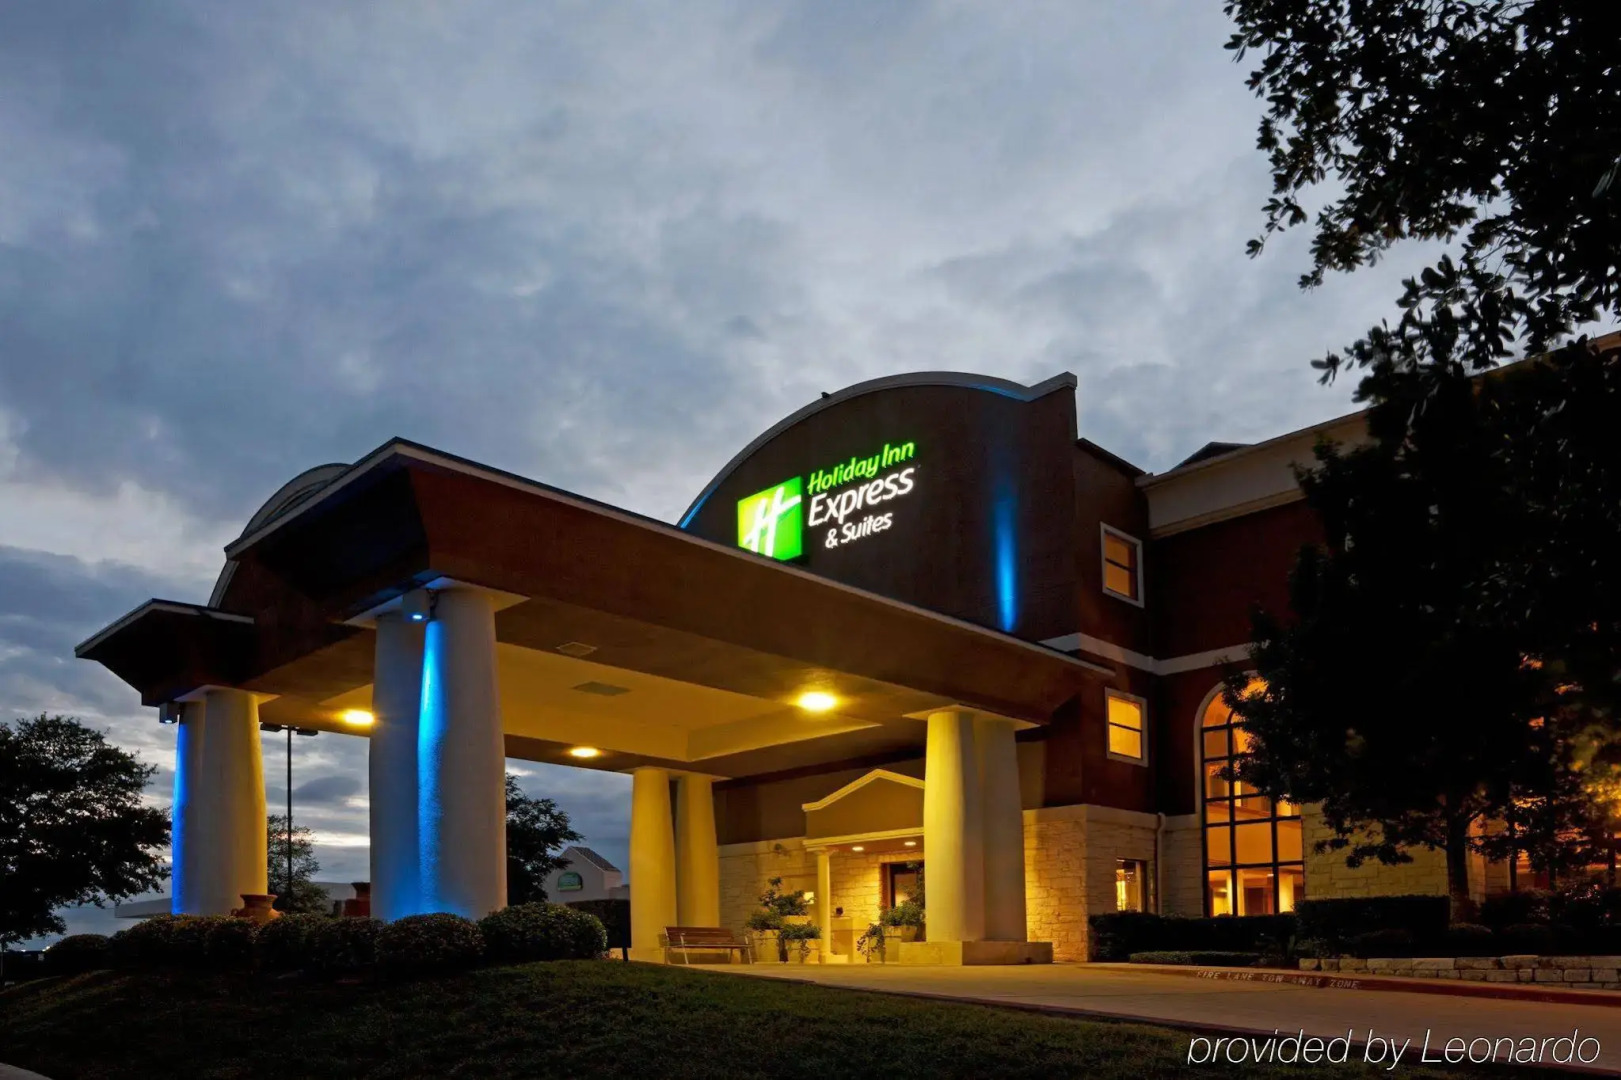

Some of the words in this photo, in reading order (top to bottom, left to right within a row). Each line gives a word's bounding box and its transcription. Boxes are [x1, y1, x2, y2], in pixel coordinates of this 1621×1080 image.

[807, 455, 880, 495] Holiday
[881, 442, 915, 468] Inn
[808, 467, 915, 527] Express
[825, 528, 839, 549] &
[840, 512, 893, 544] Suites
[1197, 971, 1221, 980] FIRE
[1227, 973, 1254, 981] LANE
[1262, 974, 1284, 983] TOW
[1292, 976, 1321, 986] AWAY
[1329, 978, 1359, 989] ZONE
